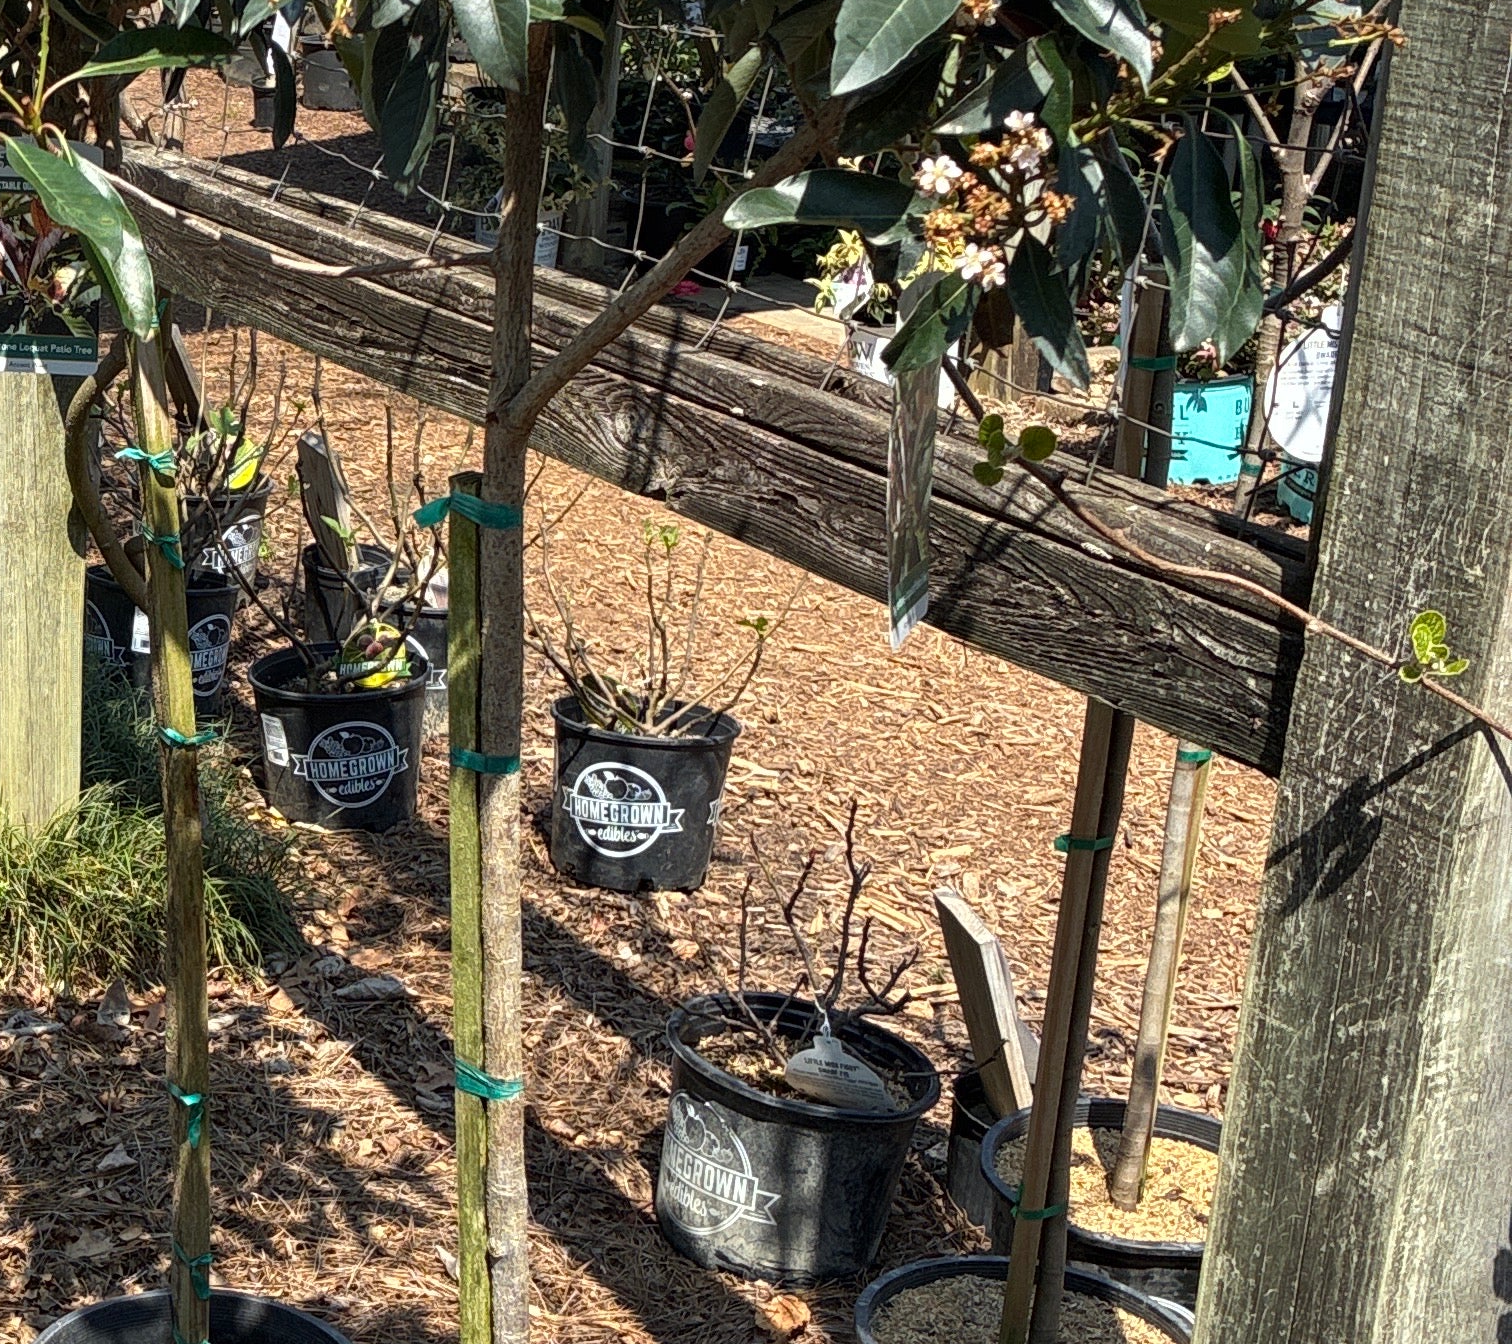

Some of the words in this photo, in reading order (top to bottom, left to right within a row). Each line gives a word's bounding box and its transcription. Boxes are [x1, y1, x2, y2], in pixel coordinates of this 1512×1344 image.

[50, 344, 72, 354] Patio
[73, 345, 93, 355] Tree
[310, 750, 395, 779] HOMEGROWN
[338, 778, 376, 796] edibles
[574, 797, 663, 824] HOMEGROWN
[598, 826, 637, 842] edibles
